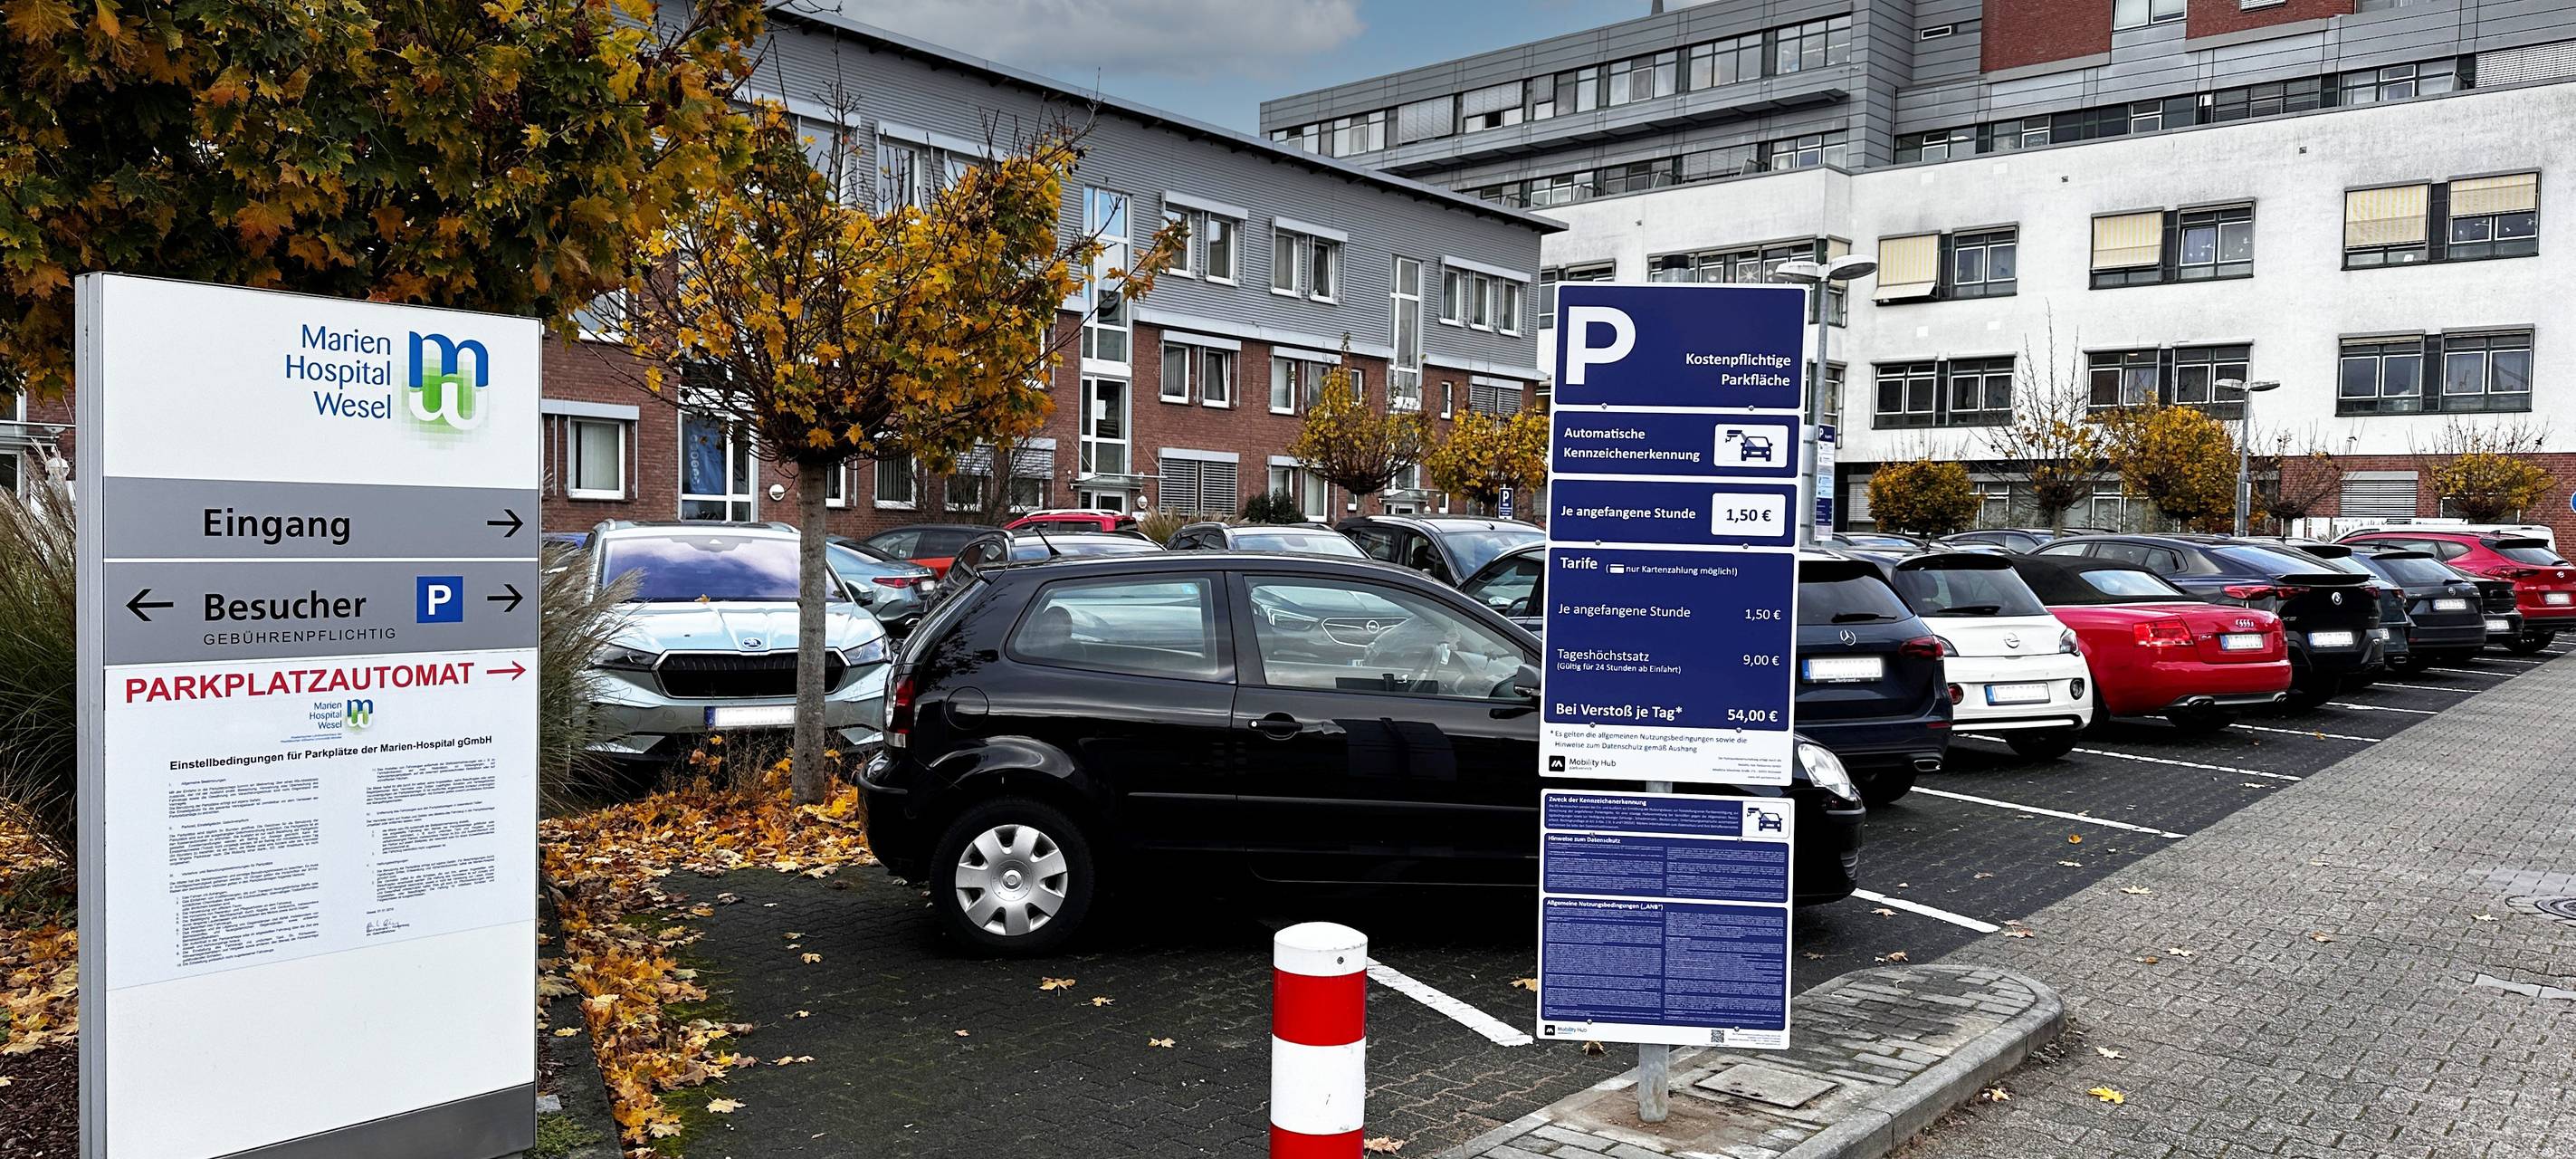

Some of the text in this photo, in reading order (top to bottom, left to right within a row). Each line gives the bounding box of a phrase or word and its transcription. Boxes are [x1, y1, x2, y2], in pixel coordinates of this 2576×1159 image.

[302, 324, 391, 355] Marien
[1566, 306, 1636, 385] P
[1685, 353, 1791, 368] Kostenpflichtige
[285, 354, 391, 388] Hospital
[1721, 373, 1790, 387] Parkfläche
[313, 391, 391, 419] Wesel
[1564, 427, 1646, 439] Automatische
[1563, 447, 1700, 463] Kennzeichenerkennung
[1503, 491, 1509, 503] P
[1560, 506, 1696, 520] Je angefangene Stunde
[1726, 509, 1771, 523] 1,50 €
[204, 509, 351, 545] Eingang
[1560, 557, 1598, 570] Tarife
[1642, 565, 1698, 576] Kartenzahlung
[1700, 567, 1737, 577] möglich!)
[204, 585, 452, 622] Besucher P
[1559, 604, 1691, 618] Je angefangene Stunde
[1745, 609, 1780, 621] 1,50 €
[203, 627, 396, 646] GEBÜHRENPFLICHTIG
[1557, 648, 1649, 662] Tageshöchstsatz
[1743, 655, 1779, 667] 9,00 €
[1557, 663, 1581, 671] (Gültig
[1649, 665, 1681, 674] Einfahrt)
[126, 663, 474, 703] PARKPLATZAUTOMAT
[314, 702, 342, 710] Marien
[1556, 704, 1577, 715] Bei
[1580, 704, 1633, 717] Verstoß
[1636, 706, 1648, 720] je
[309, 710, 342, 721] Hospital
[1727, 709, 1778, 723] 54,00 €
[318, 721, 342, 729] Wesel
[1564, 731, 1584, 739] gelten
[1598, 732, 1638, 740] allgemeinen
[1640, 733, 1713, 742] Nutzungsbedingungen
[169, 735, 492, 771] Einstellbedingungen für Parkplätze der Marien-Hospital gGmbH
[1668, 745, 1697, 753] Aushang
[1569, 758, 1599, 768] Mobility
